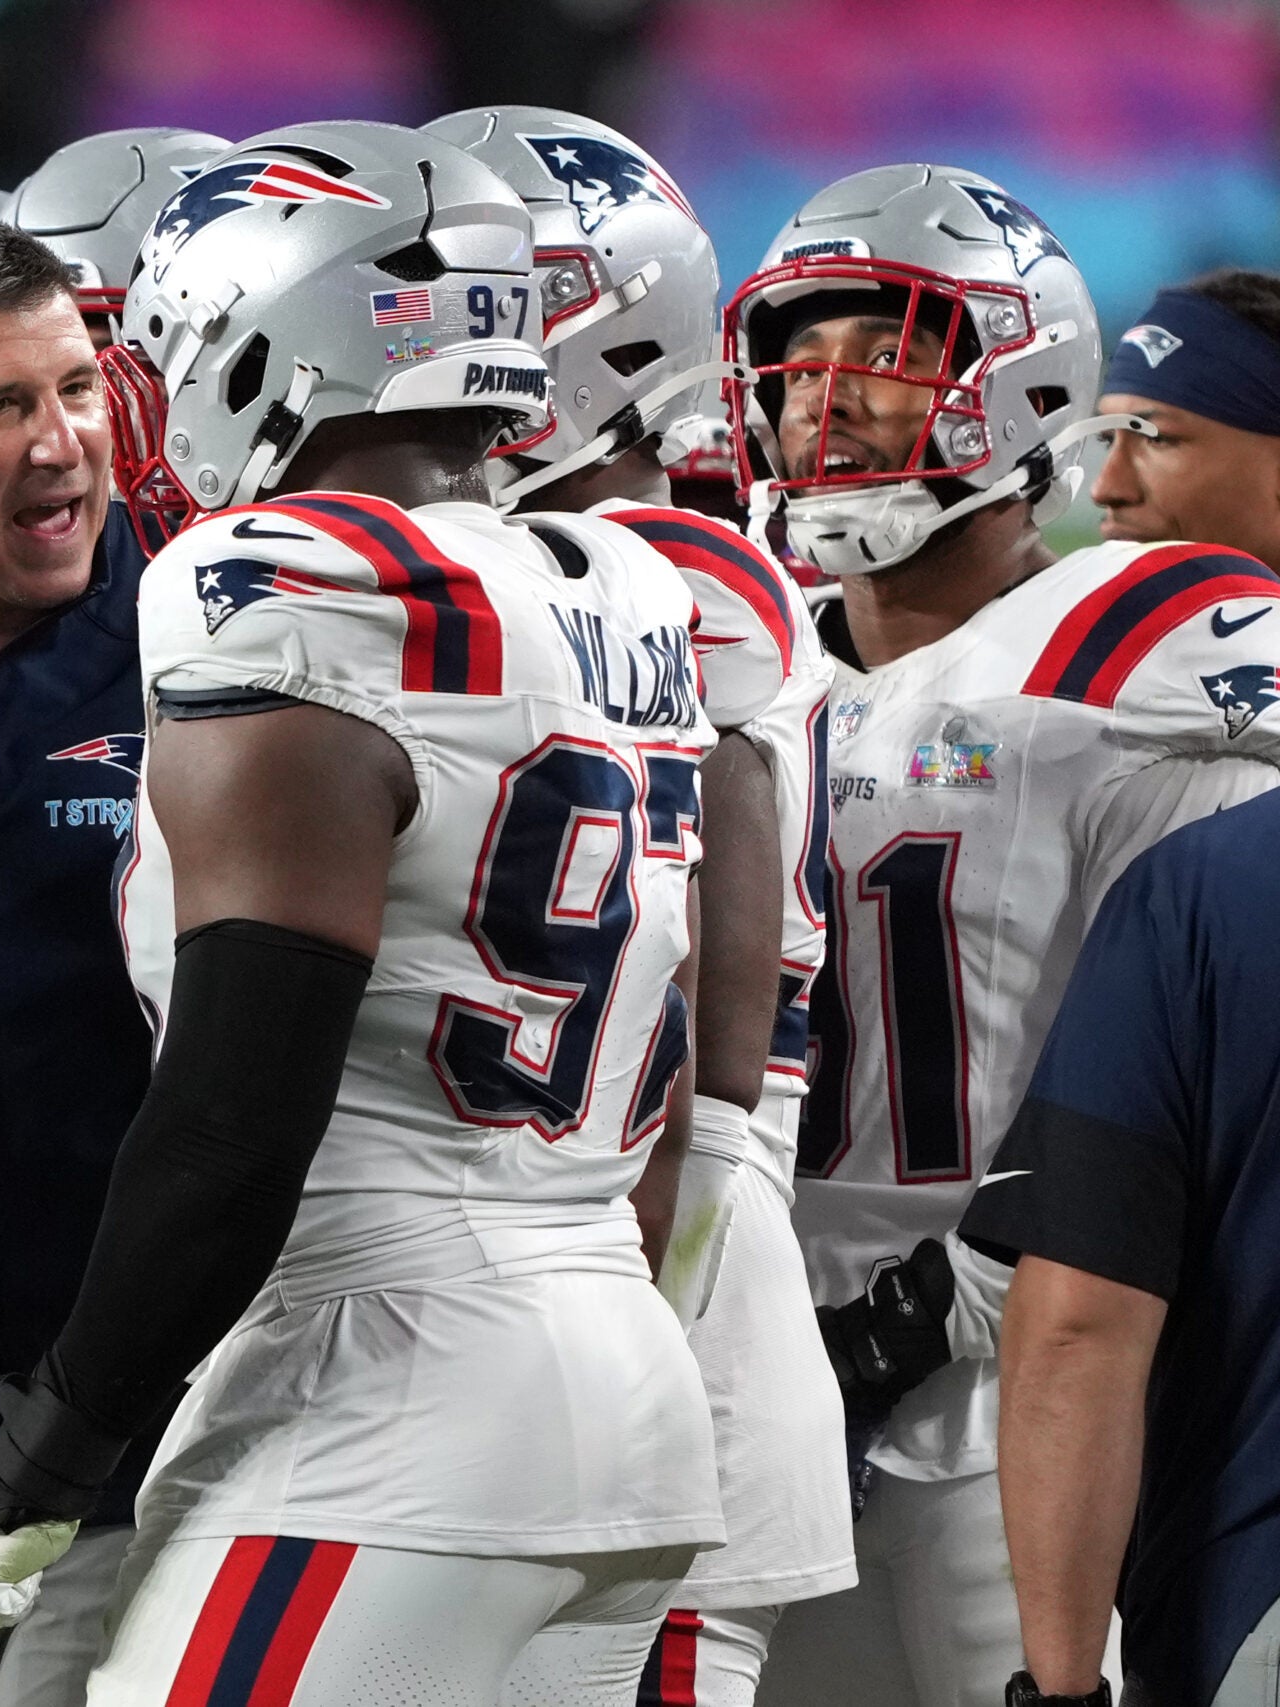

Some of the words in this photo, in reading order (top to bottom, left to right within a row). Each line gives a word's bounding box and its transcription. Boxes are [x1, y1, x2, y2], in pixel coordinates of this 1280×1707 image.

[466, 285, 529, 340] 97
[830, 777, 877, 801] RIOTS
[44, 799, 63, 827] T
[66, 798, 138, 839] STRO
